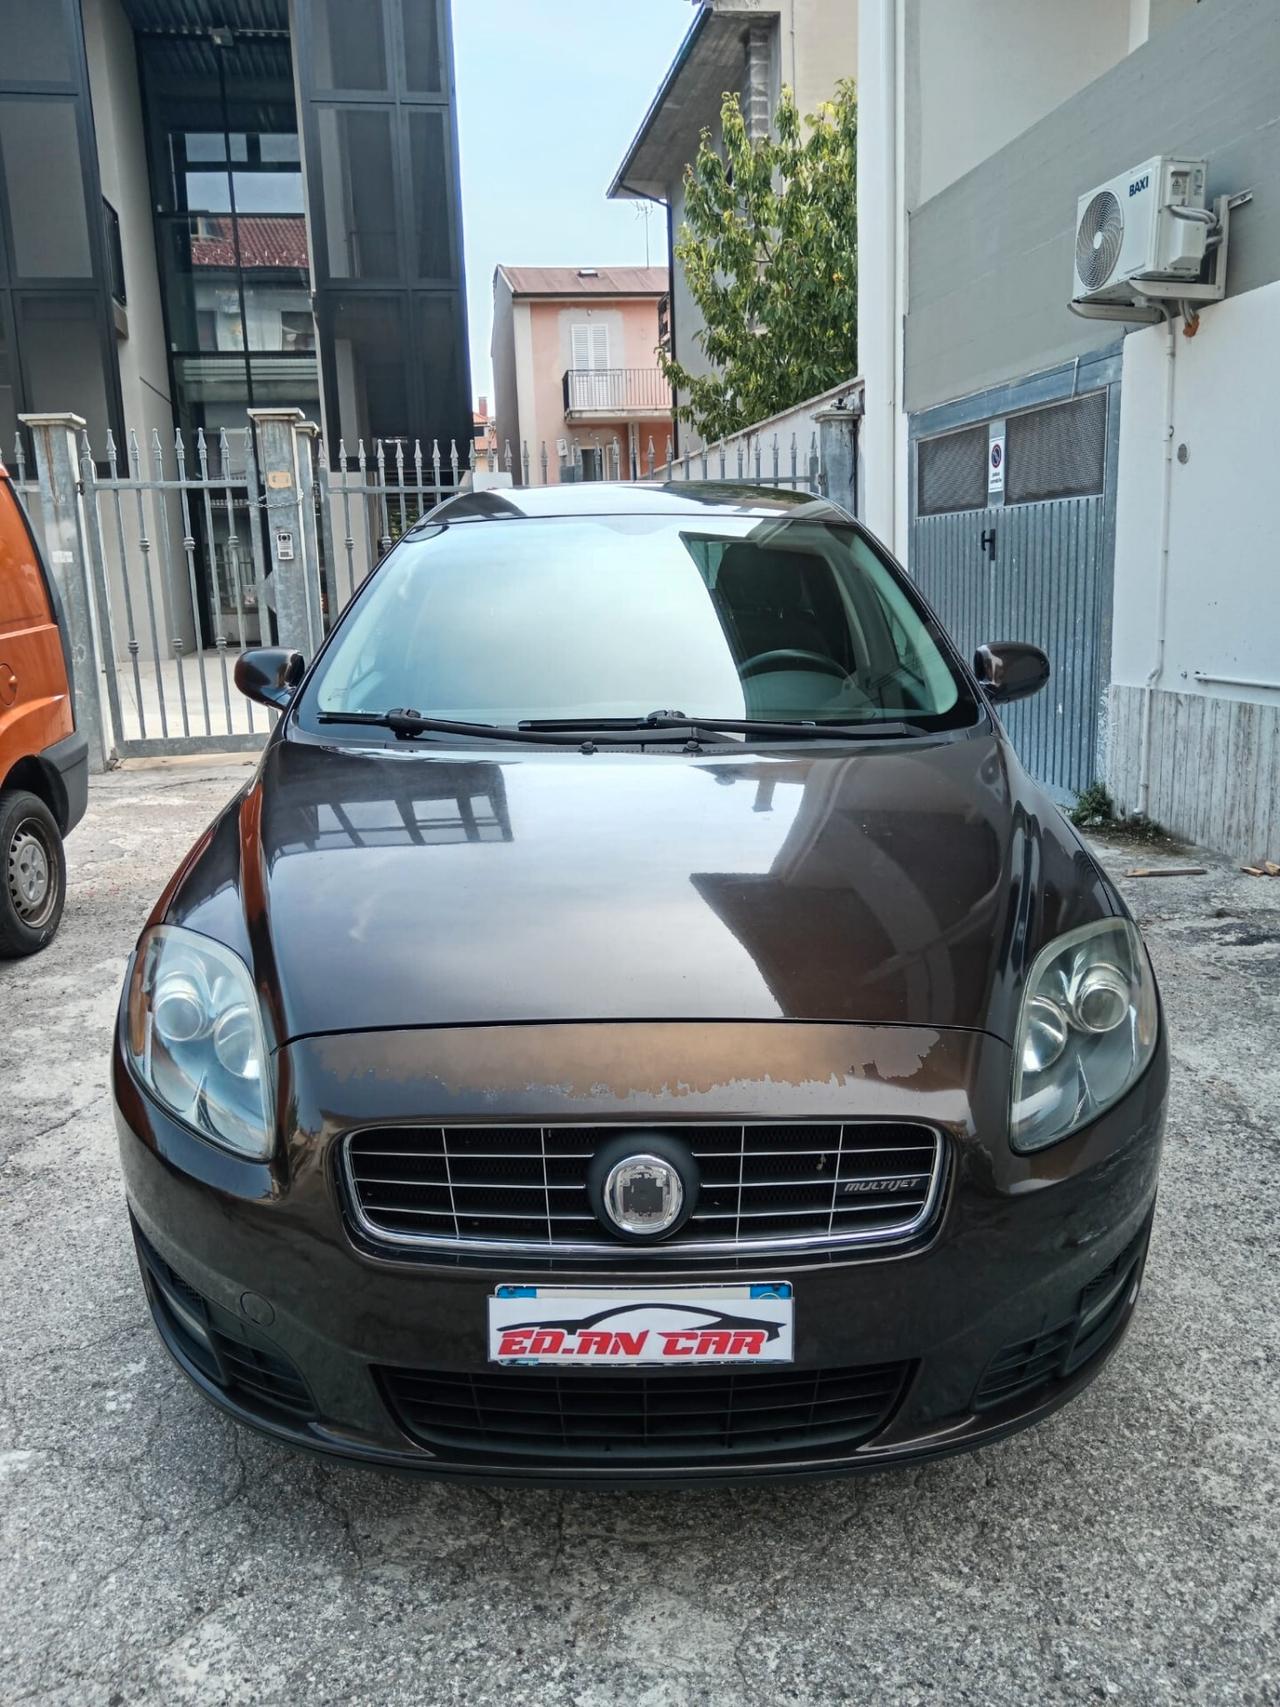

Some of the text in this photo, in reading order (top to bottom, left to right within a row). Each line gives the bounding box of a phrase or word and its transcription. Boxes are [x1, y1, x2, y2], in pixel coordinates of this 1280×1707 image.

[1129, 175, 1149, 197] BAXI
[844, 1178, 920, 1192] MULTIJET
[498, 1329, 768, 1356] ED.AN CAR
